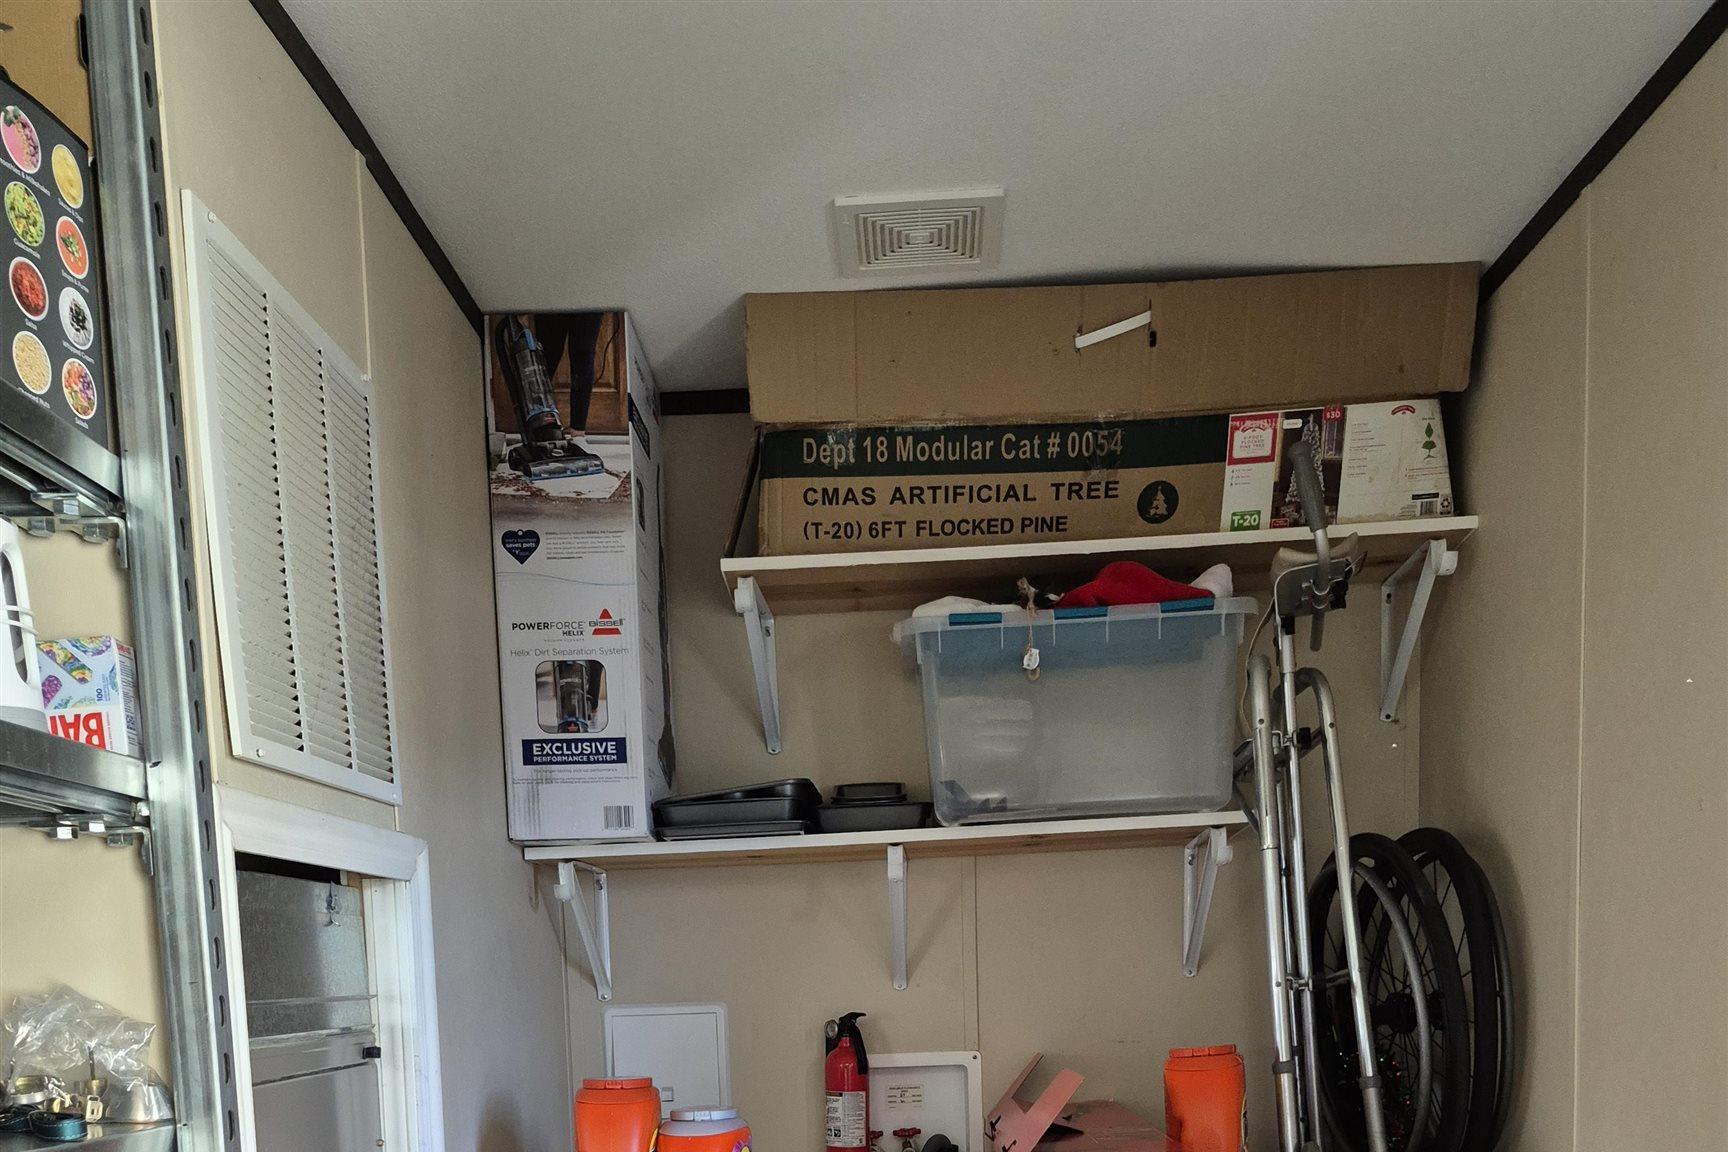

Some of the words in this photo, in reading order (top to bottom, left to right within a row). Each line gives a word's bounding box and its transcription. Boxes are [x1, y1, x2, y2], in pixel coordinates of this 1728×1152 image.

[803, 437, 856, 470] Dept
[863, 436, 888, 463] 18
[896, 434, 994, 463] Modular
[1001, 432, 1041, 460] Cat
[1047, 431, 1060, 459] #
[1067, 429, 1123, 458] 0054
[803, 486, 877, 506] CMAS
[889, 483, 1037, 506] ARTIFICIAL
[1051, 480, 1120, 501] TREE
[1232, 514, 1260, 527] T-20
[803, 520, 862, 540] (T-20)
[868, 520, 907, 539] 6FT
[915, 517, 1014, 538] FLOCKED
[1020, 516, 1068, 534] PINE
[512, 621, 585, 631] POWERFORCE
[534, 648, 549, 657] Dirt
[553, 647, 597, 657] Separation
[598, 646, 630, 657] System
[532, 741, 617, 755] EXCLUSIVE
[533, 755, 588, 763] PERFORMANCE
[589, 754, 617, 762] SYSTEM
